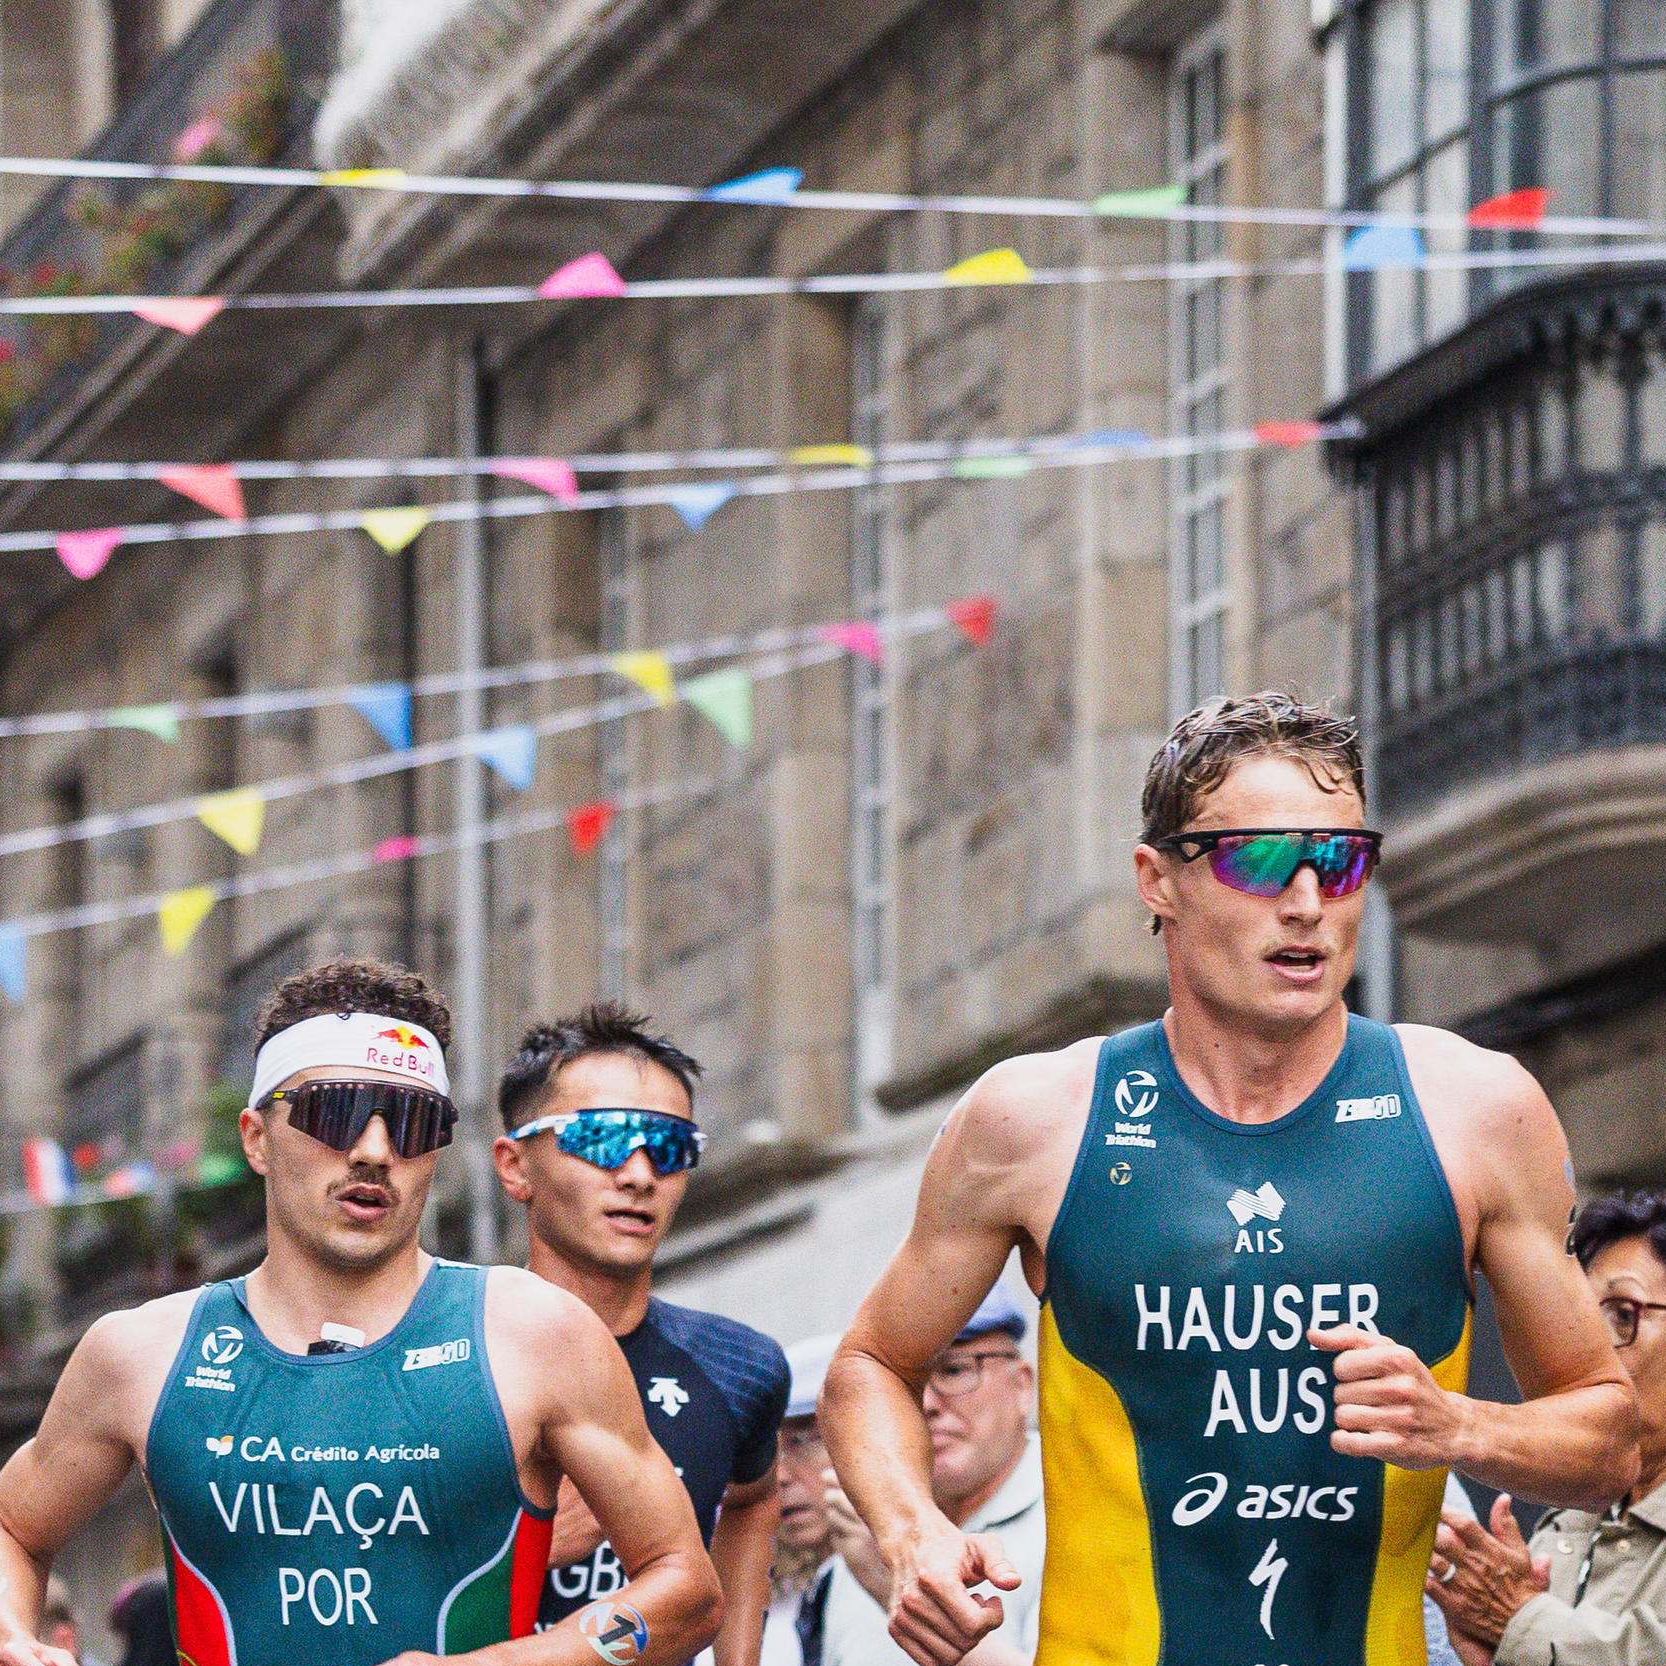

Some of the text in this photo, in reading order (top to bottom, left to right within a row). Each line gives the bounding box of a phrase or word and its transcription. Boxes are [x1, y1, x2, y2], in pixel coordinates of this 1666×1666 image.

[366, 1047, 435, 1077] Red Bull
[1105, 1134, 1157, 1149] Triathlon
[1114, 1122, 1151, 1135] World
[1234, 1228, 1284, 1253] AIS
[1134, 1283, 1381, 1351] HAUSER
[185, 1376, 236, 1392] Triathlon
[196, 1366, 232, 1380] World
[1203, 1367, 1328, 1438] AUS
[240, 1436, 441, 1464] CA Crédito Agrícola
[208, 1481, 431, 1550] VILAÇA
[1236, 1484, 1359, 1522] asics
[278, 1567, 379, 1626] POR
[597, 1614, 637, 1646] 1
